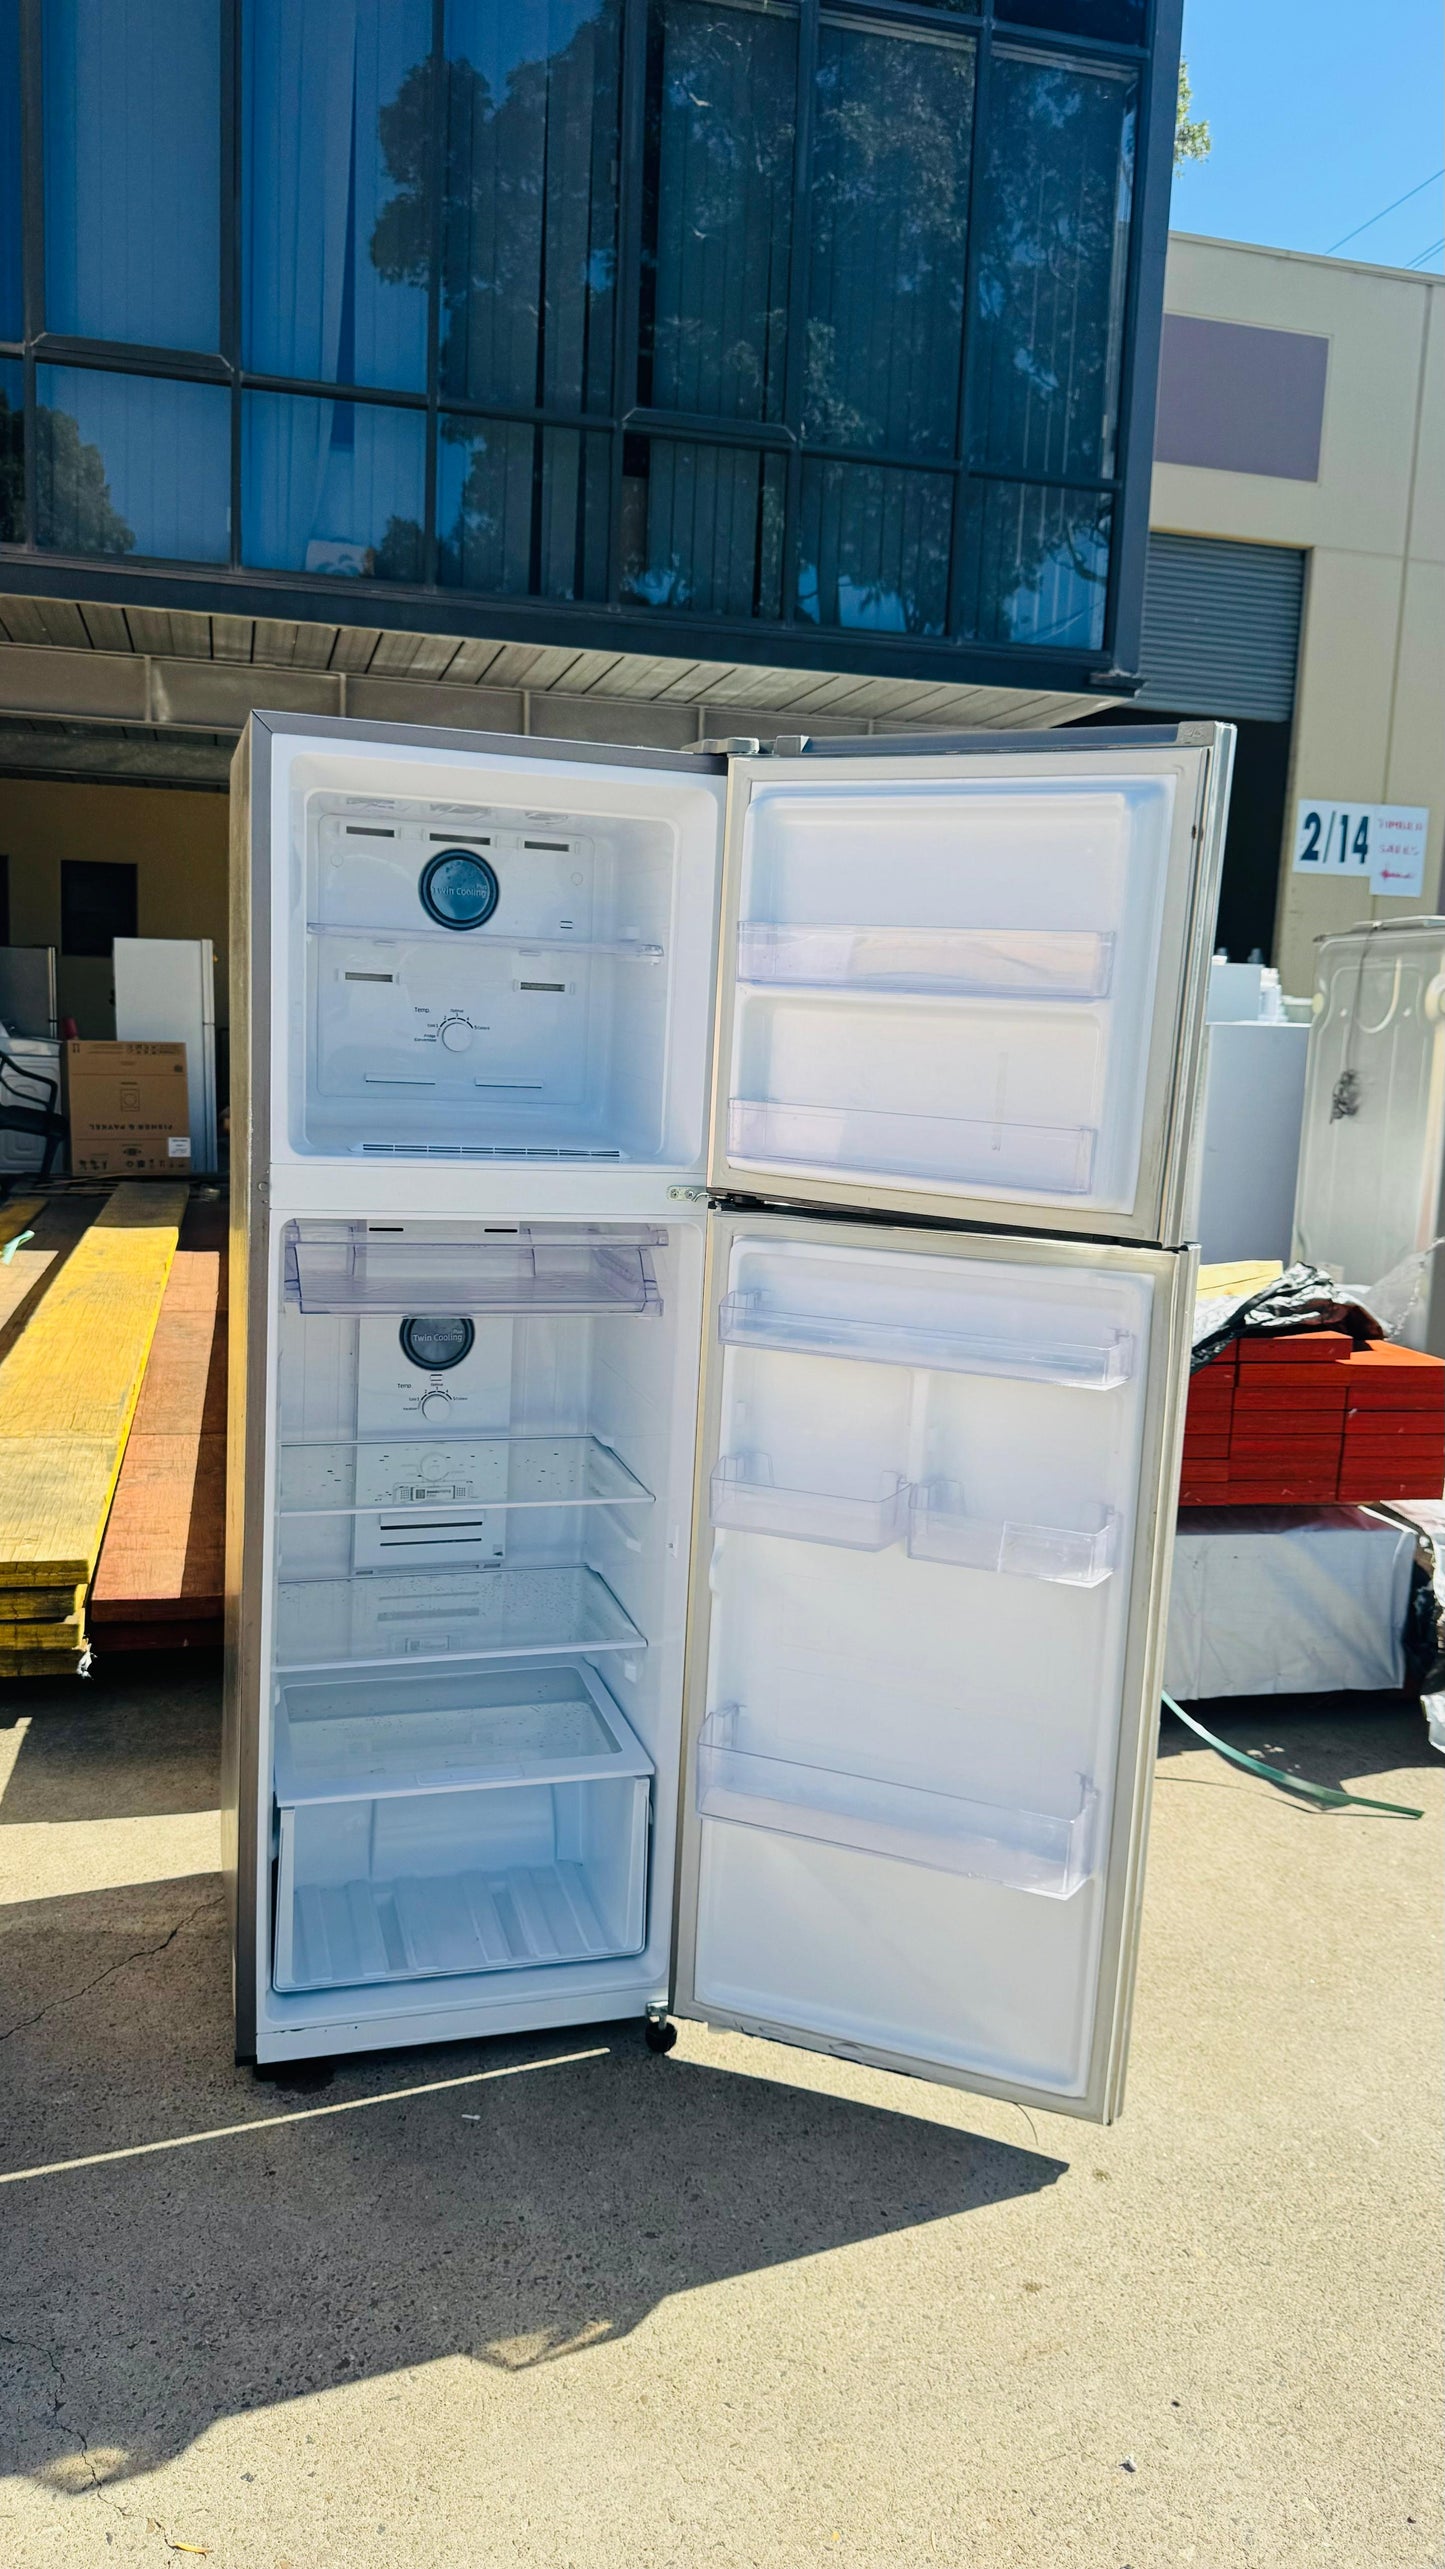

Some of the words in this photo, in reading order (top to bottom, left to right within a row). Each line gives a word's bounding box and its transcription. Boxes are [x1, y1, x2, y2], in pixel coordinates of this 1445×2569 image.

[1299, 810, 1369, 865] 2/14
[431, 886, 454, 896] Twin
[456, 886, 487, 899] Cooling
[413, 1333, 432, 1342] Twin
[433, 1332, 463, 1343] Cooling
